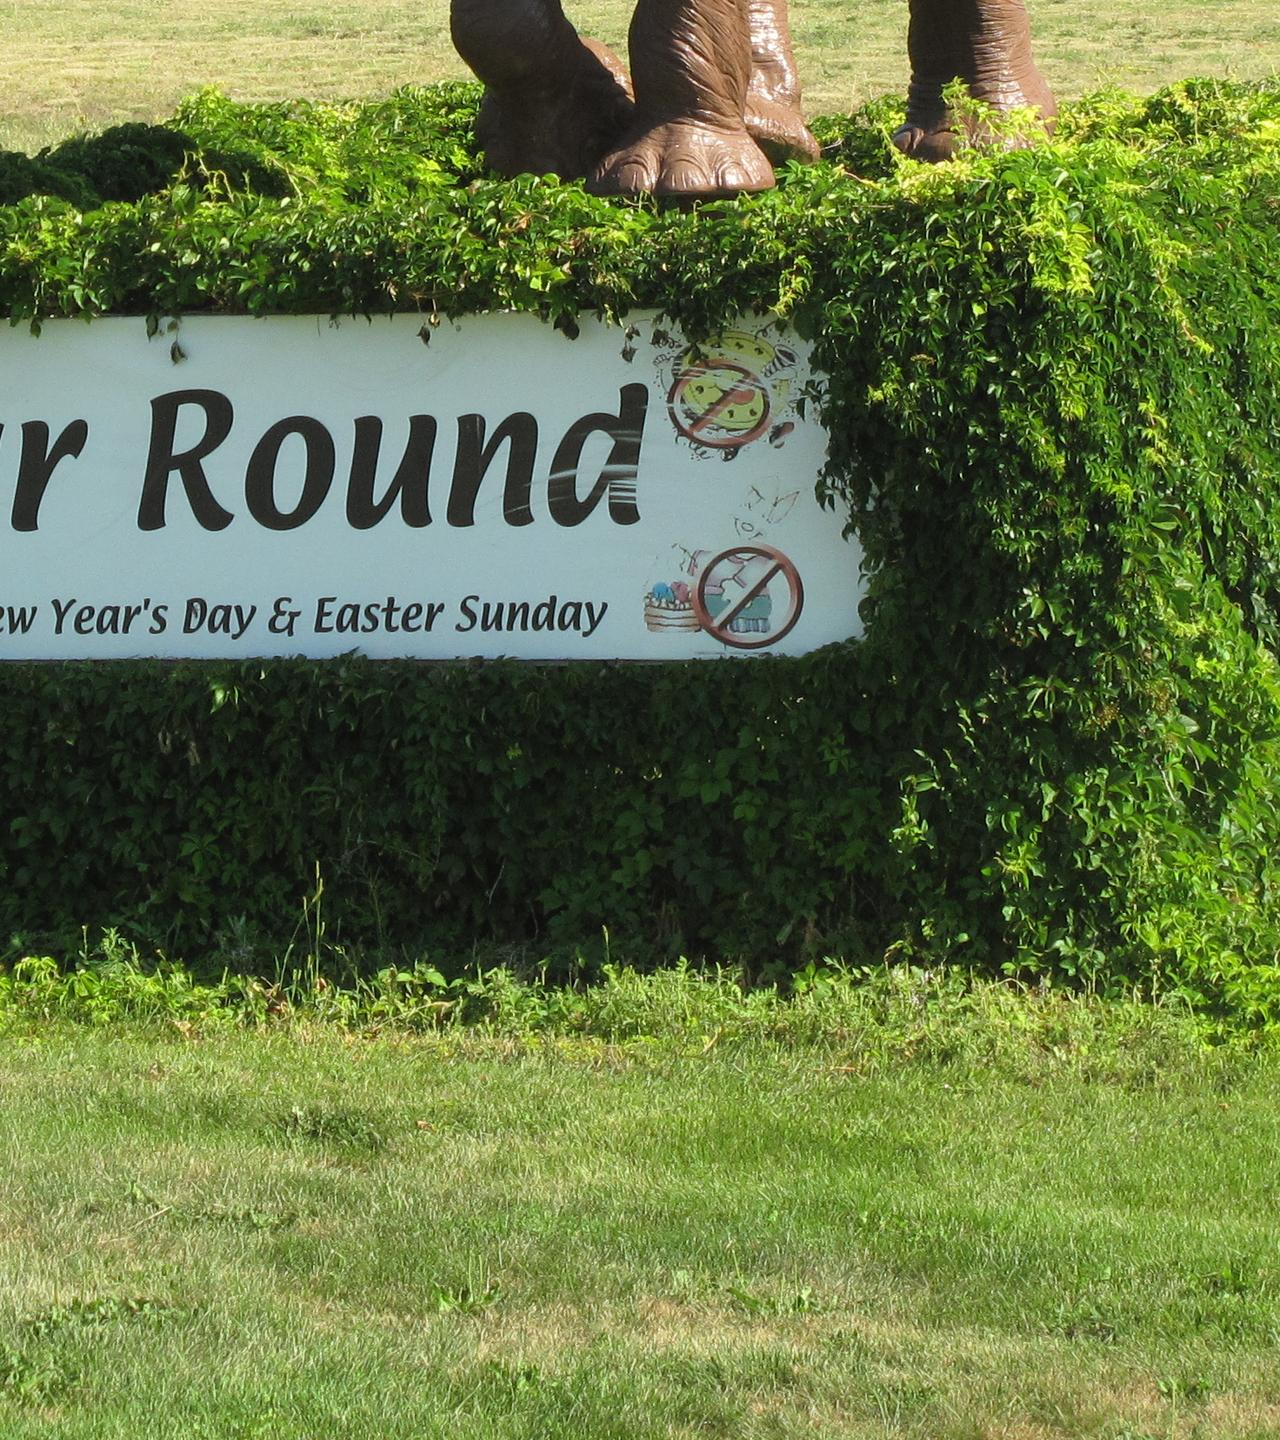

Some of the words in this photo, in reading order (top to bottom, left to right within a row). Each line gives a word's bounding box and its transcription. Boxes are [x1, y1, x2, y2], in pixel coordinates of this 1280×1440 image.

[137, 381, 650, 532] Round
[50, 597, 169, 635] Year's
[182, 597, 257, 641] Day
[268, 596, 302, 638] &
[314, 596, 445, 634] Easter
[457, 594, 609, 639] Sunday
